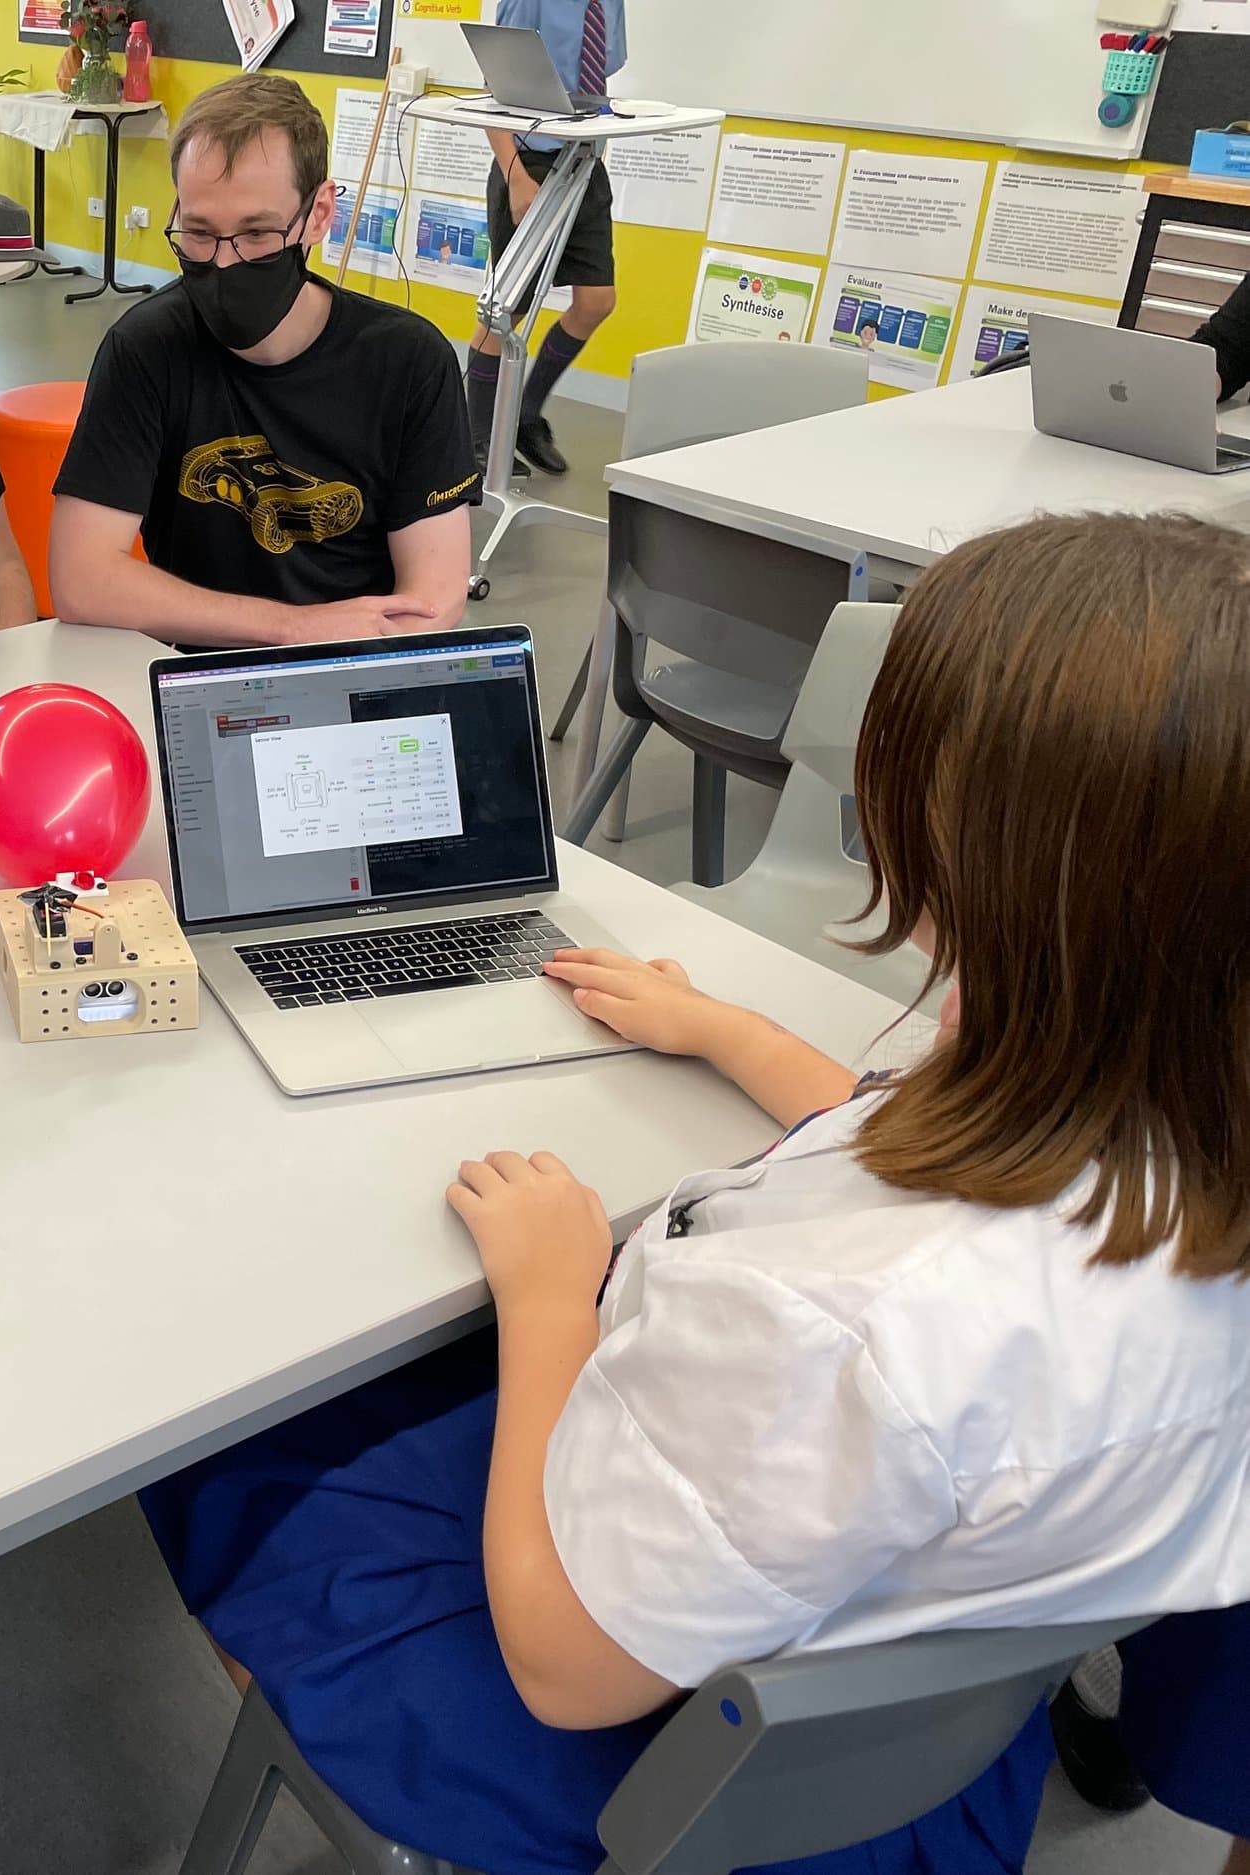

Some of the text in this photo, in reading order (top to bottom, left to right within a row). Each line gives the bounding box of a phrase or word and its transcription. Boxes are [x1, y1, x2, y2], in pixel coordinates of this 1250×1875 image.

[847, 274, 883, 289] Evaluate
[721, 294, 784, 320] Synthesise
[988, 304, 1014, 316] Make
